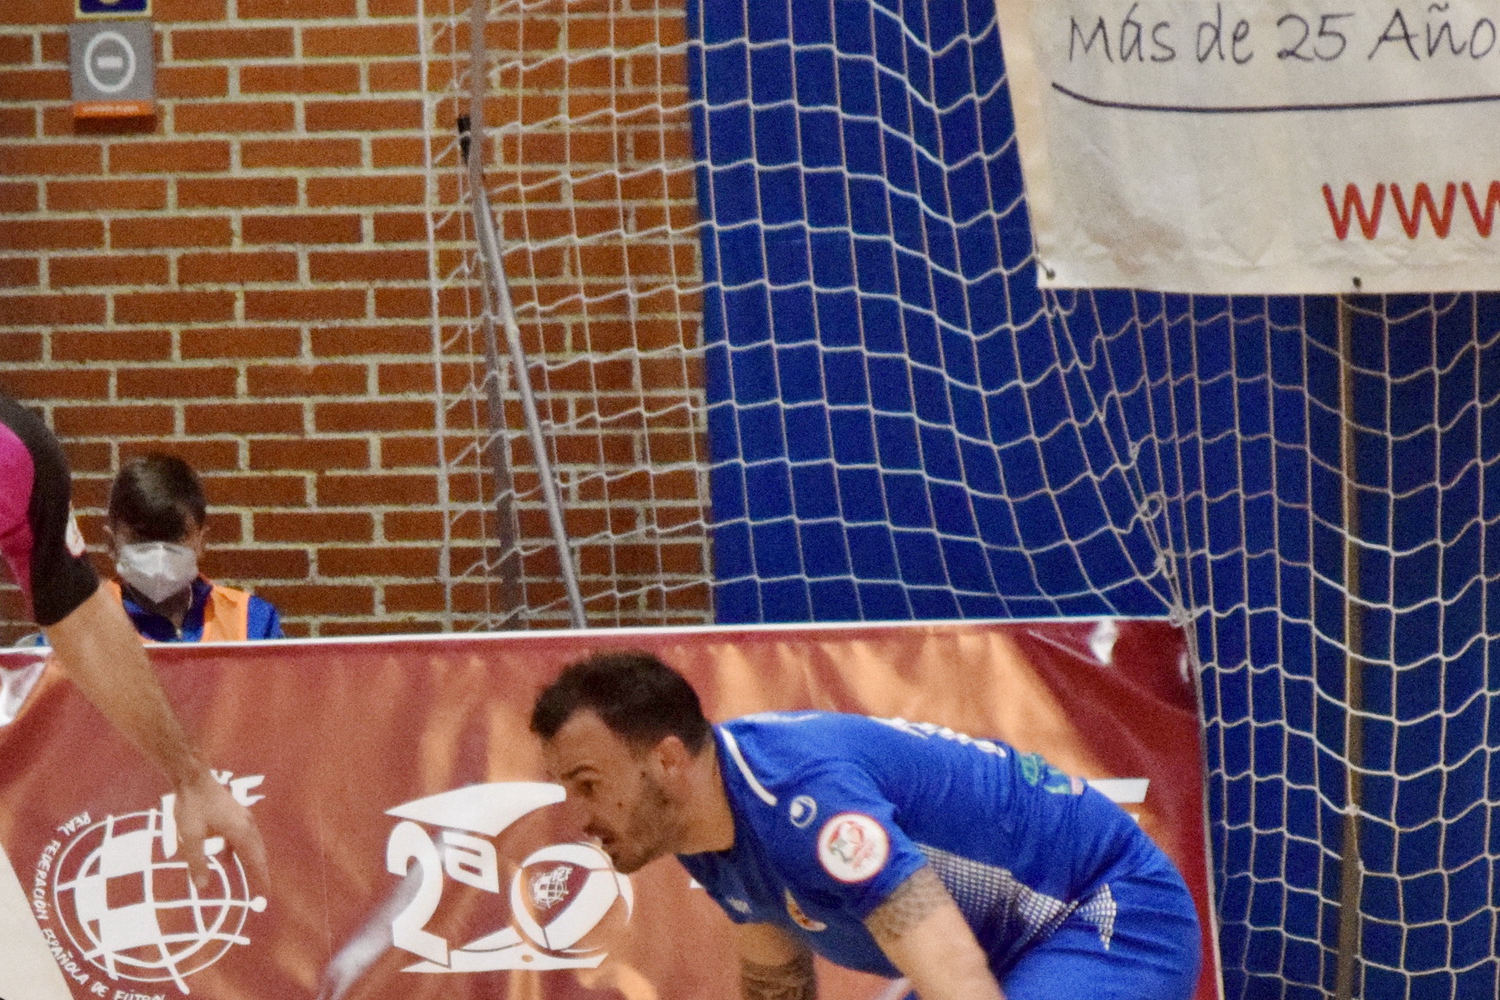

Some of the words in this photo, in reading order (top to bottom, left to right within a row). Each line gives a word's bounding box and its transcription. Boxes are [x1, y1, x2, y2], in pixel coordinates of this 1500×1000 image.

[1069, 3, 1177, 64] Más
[1196, 3, 1255, 64] de
[1276, 13, 1355, 61] 25
[1367, 3, 1500, 61] Año
[91, 980, 110, 997] DE
